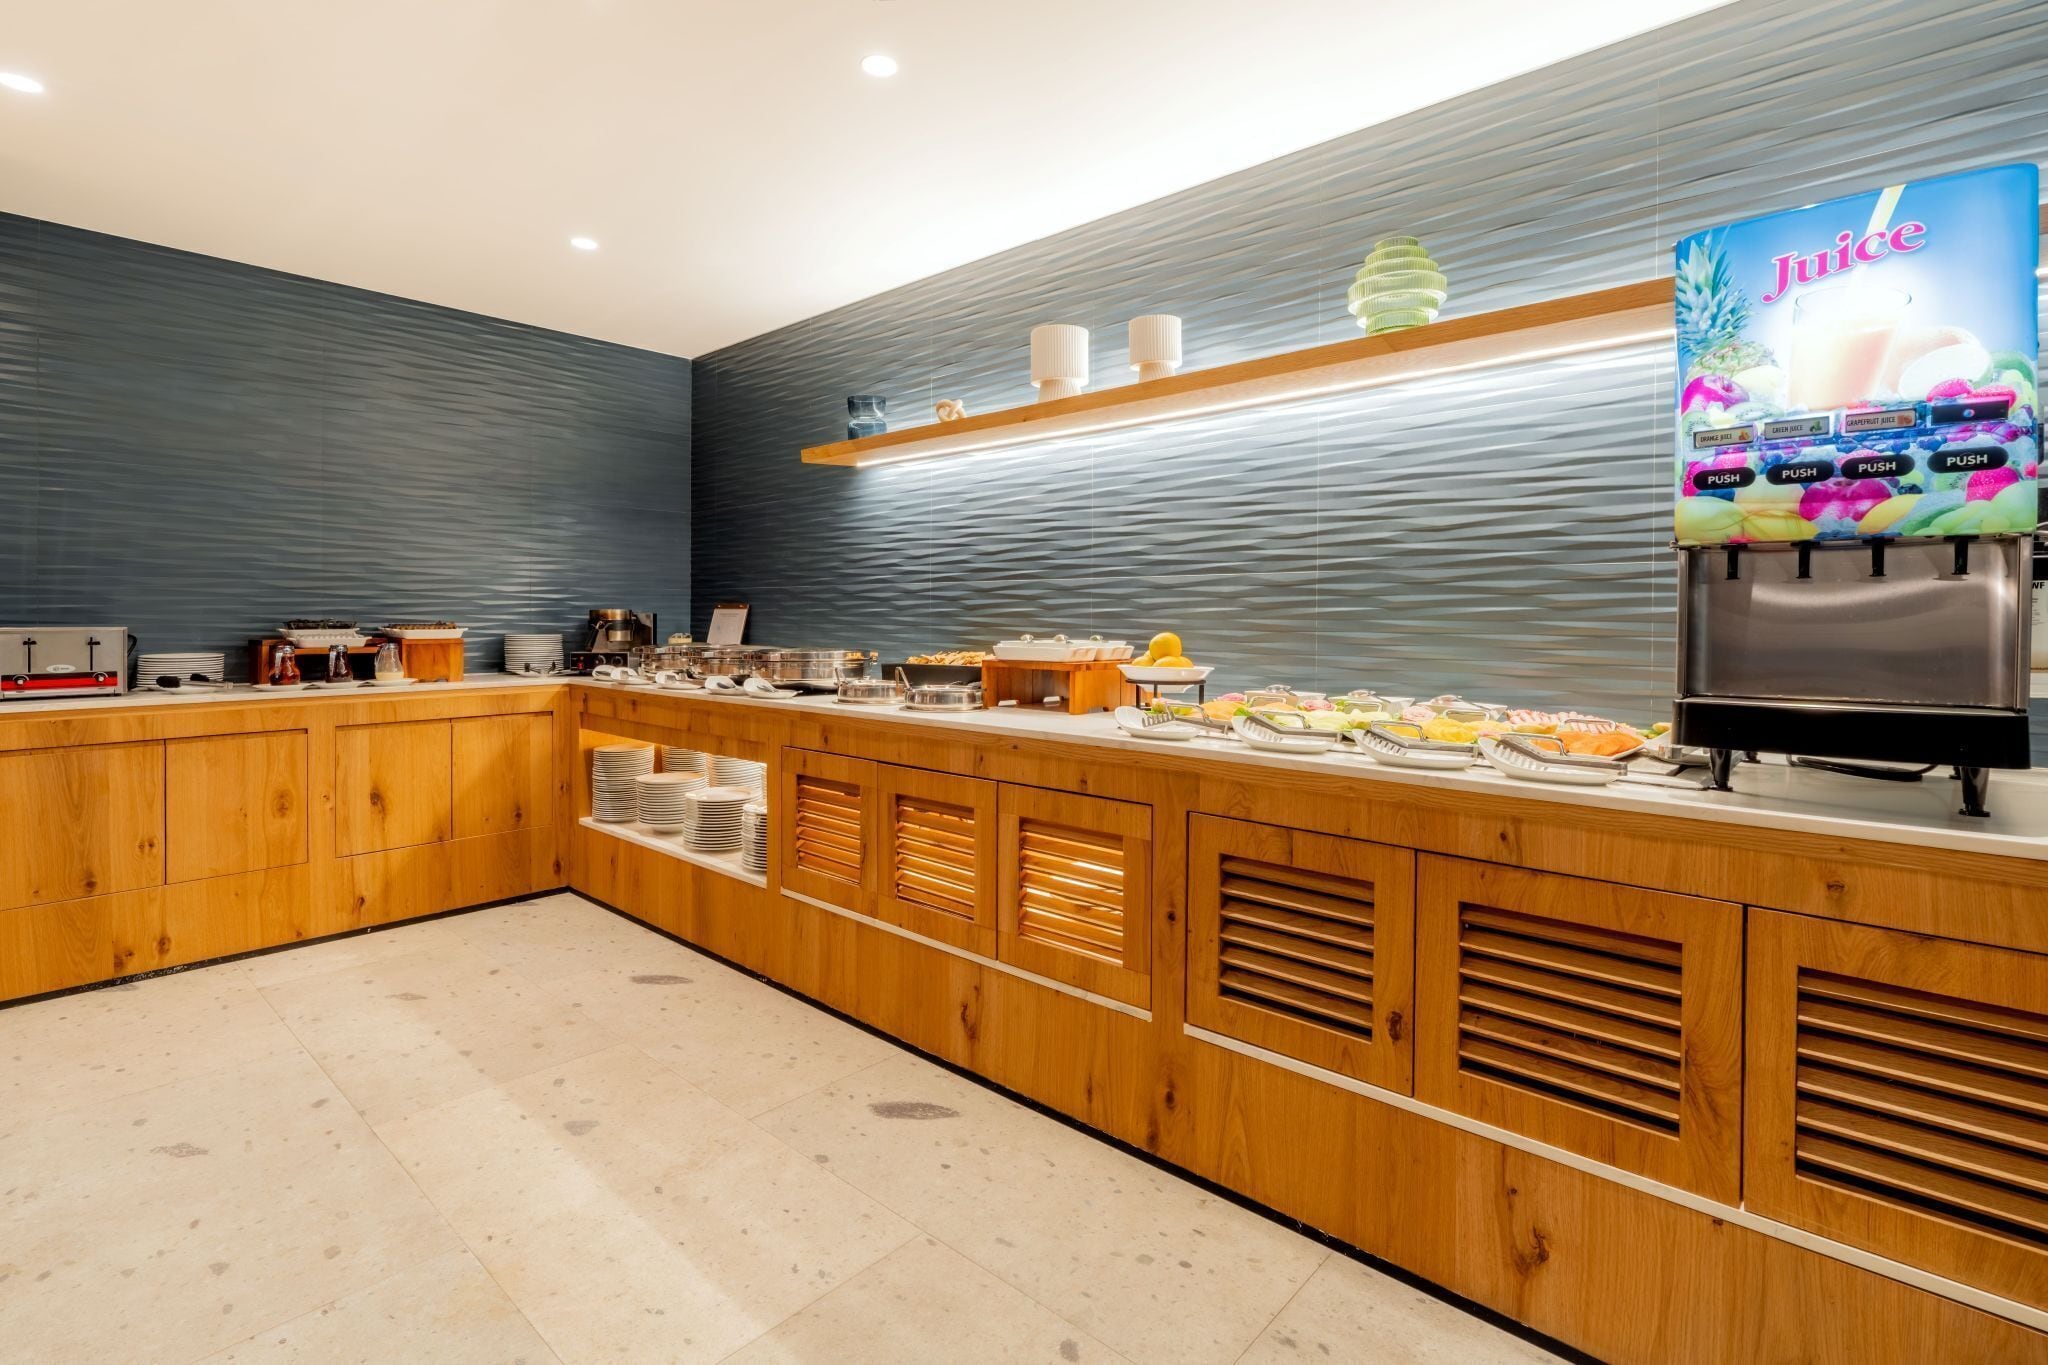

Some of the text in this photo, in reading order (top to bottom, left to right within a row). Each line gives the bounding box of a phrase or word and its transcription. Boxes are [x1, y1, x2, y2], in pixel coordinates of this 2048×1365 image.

[1760, 220, 1926, 304] Juice
[1846, 416, 1896, 427] GRAPEFRUIT JUICE
[1772, 424, 1803, 434] GREEN JUICE
[1700, 434, 1719, 443] ORANGE
[1946, 453, 1988, 467] PUSH
[1781, 467, 1817, 479] PUSH
[1857, 461, 1896, 473] PUSH
[1707, 473, 1740, 485] PUSH
